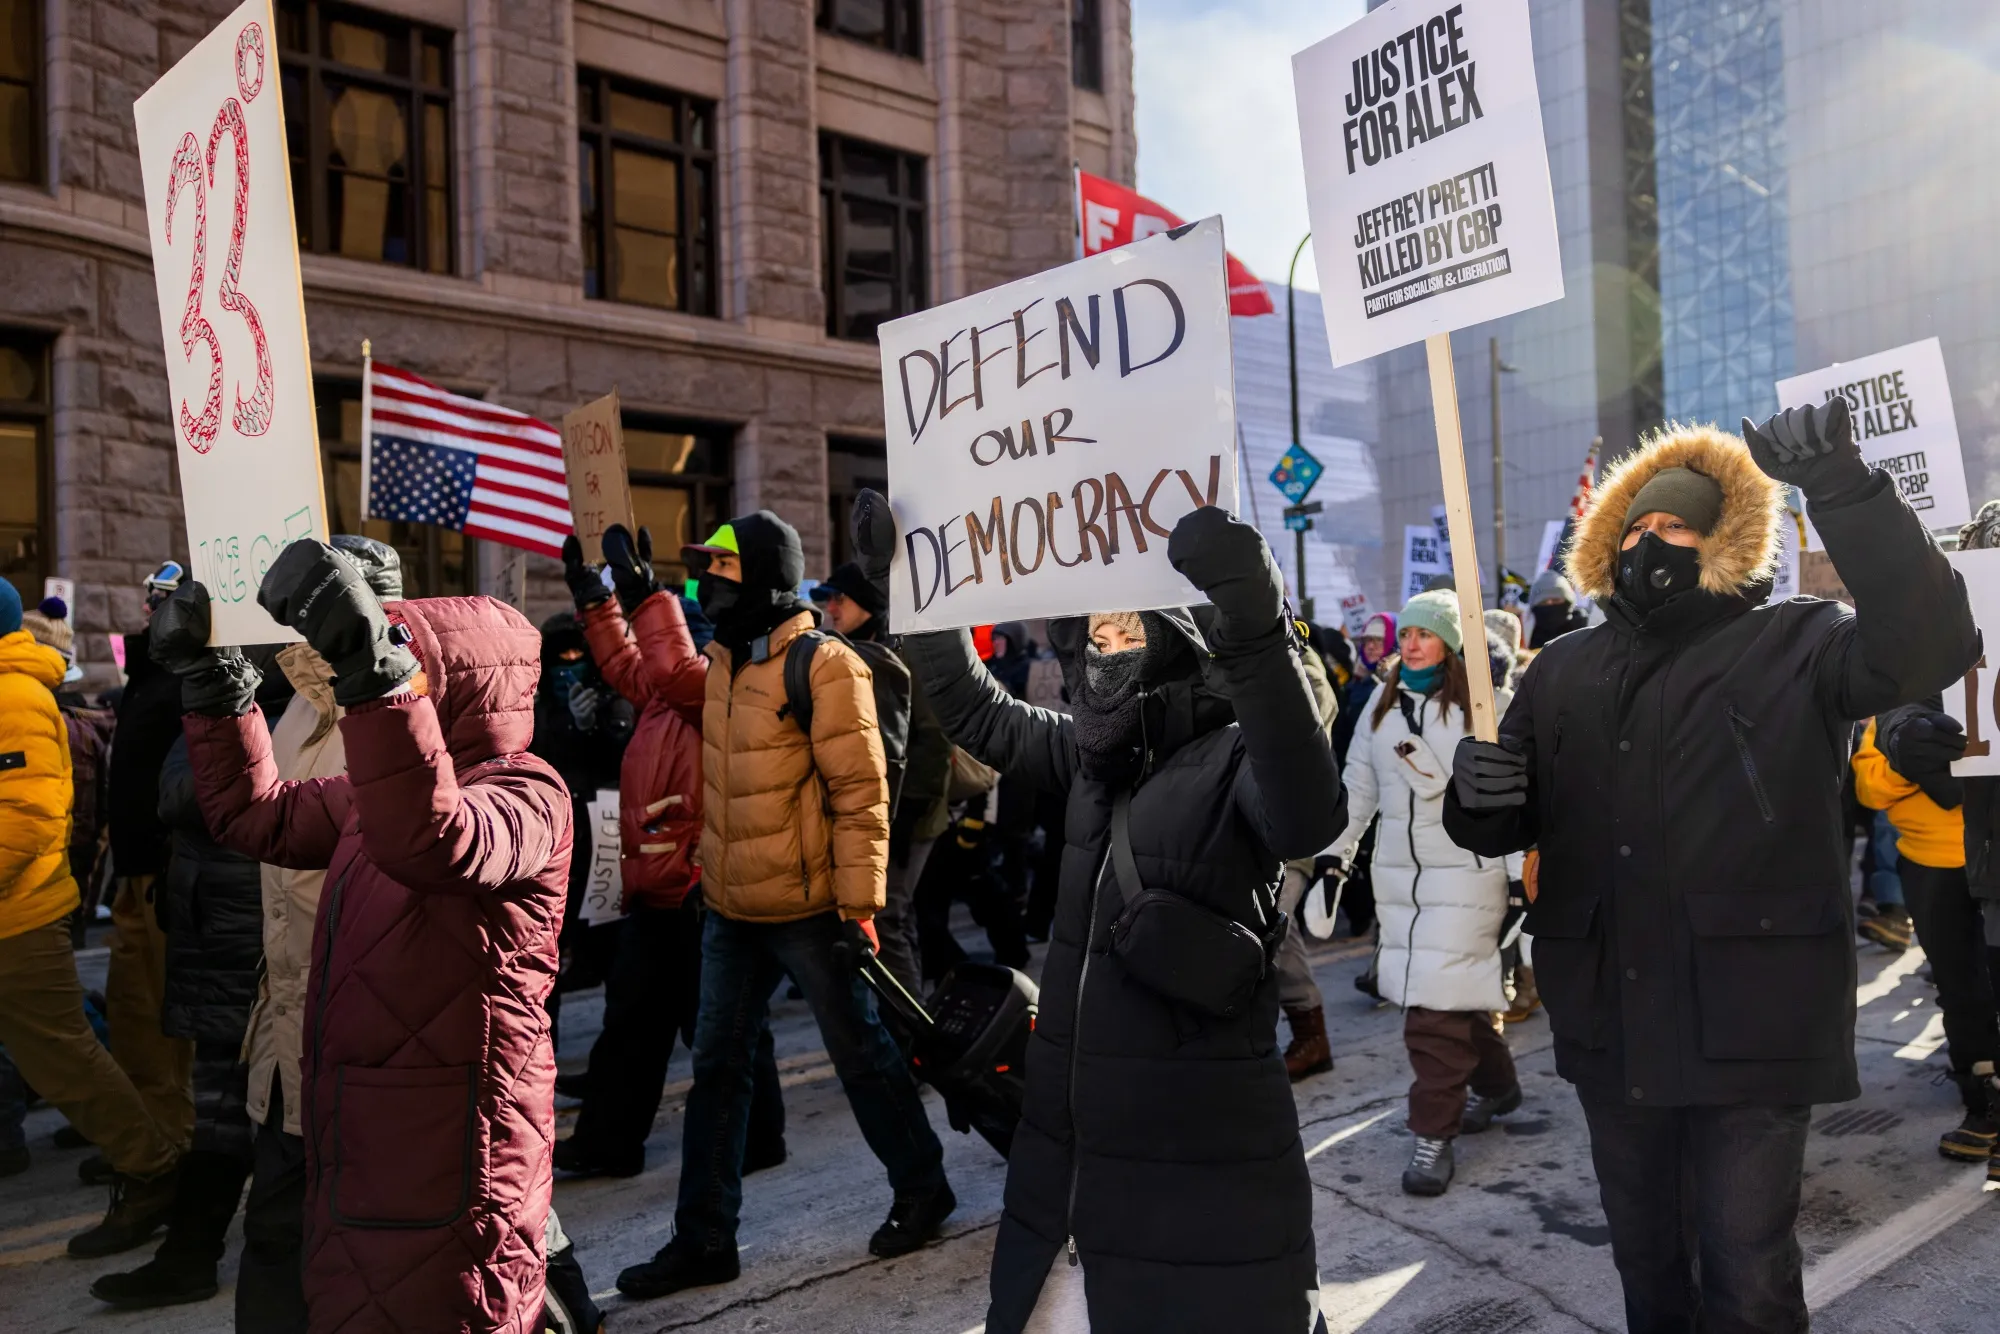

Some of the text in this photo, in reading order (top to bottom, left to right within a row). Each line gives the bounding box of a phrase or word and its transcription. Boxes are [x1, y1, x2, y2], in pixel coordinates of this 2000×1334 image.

[1345, 3, 1469, 117] JUSTICE
[1343, 60, 1485, 176] FOR ALEX
[1354, 161, 1498, 249] JEFFREY PRETTI
[1357, 203, 1503, 290] KILLED BY CBP
[1366, 254, 1509, 315] PARTY FOR SOCIALISM & LIBERATION
[899, 278, 1186, 446] DEFEND
[1824, 370, 1909, 412] STICE
[569, 420, 613, 463] PRISON
[969, 407, 1098, 467] OUR
[1865, 399, 1919, 440] ALEX
[1898, 472, 1929, 496] CBP
[905, 454, 1221, 615] DEMOCRACY
[588, 810, 621, 910] JUSTICE
